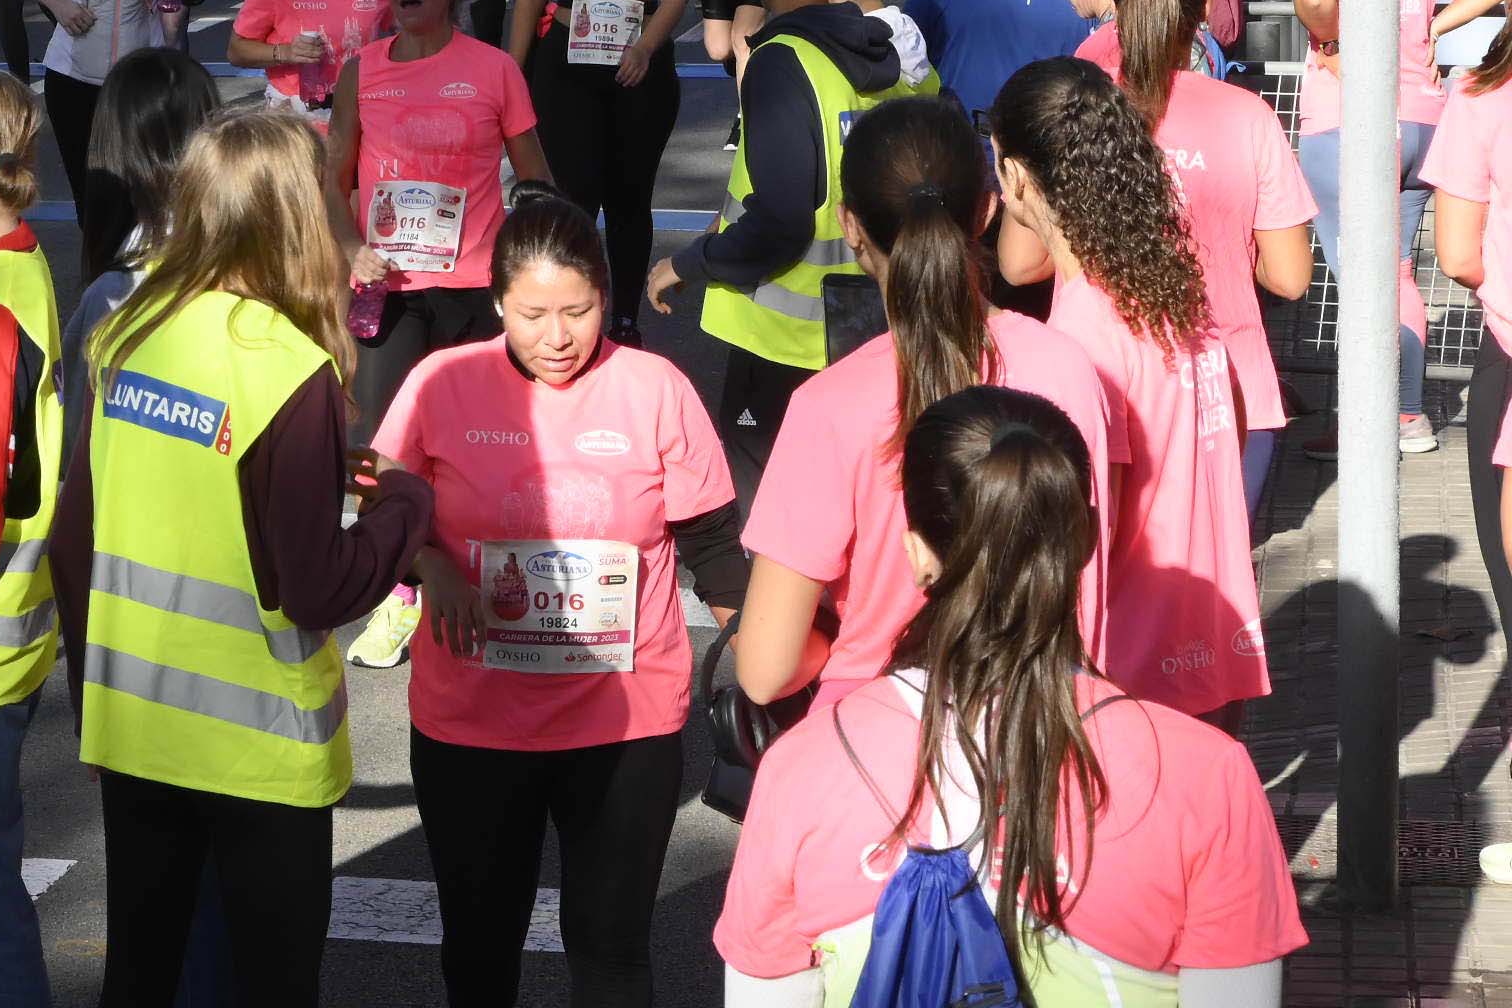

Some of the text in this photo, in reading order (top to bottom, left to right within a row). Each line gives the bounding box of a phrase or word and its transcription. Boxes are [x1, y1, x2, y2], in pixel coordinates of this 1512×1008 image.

[592, 22, 618, 34] 016
[400, 216, 426, 229] 016
[736, 418, 757, 426] adidas
[466, 429, 529, 446] OYSHO
[531, 560, 588, 574] ASTURIANA
[598, 557, 627, 566] SUMA
[534, 591, 585, 611] 016
[538, 617, 578, 629] 19824
[496, 648, 541, 663] OYSHO
[577, 652, 625, 664] Santander
[1161, 649, 1216, 674] OYSHO
